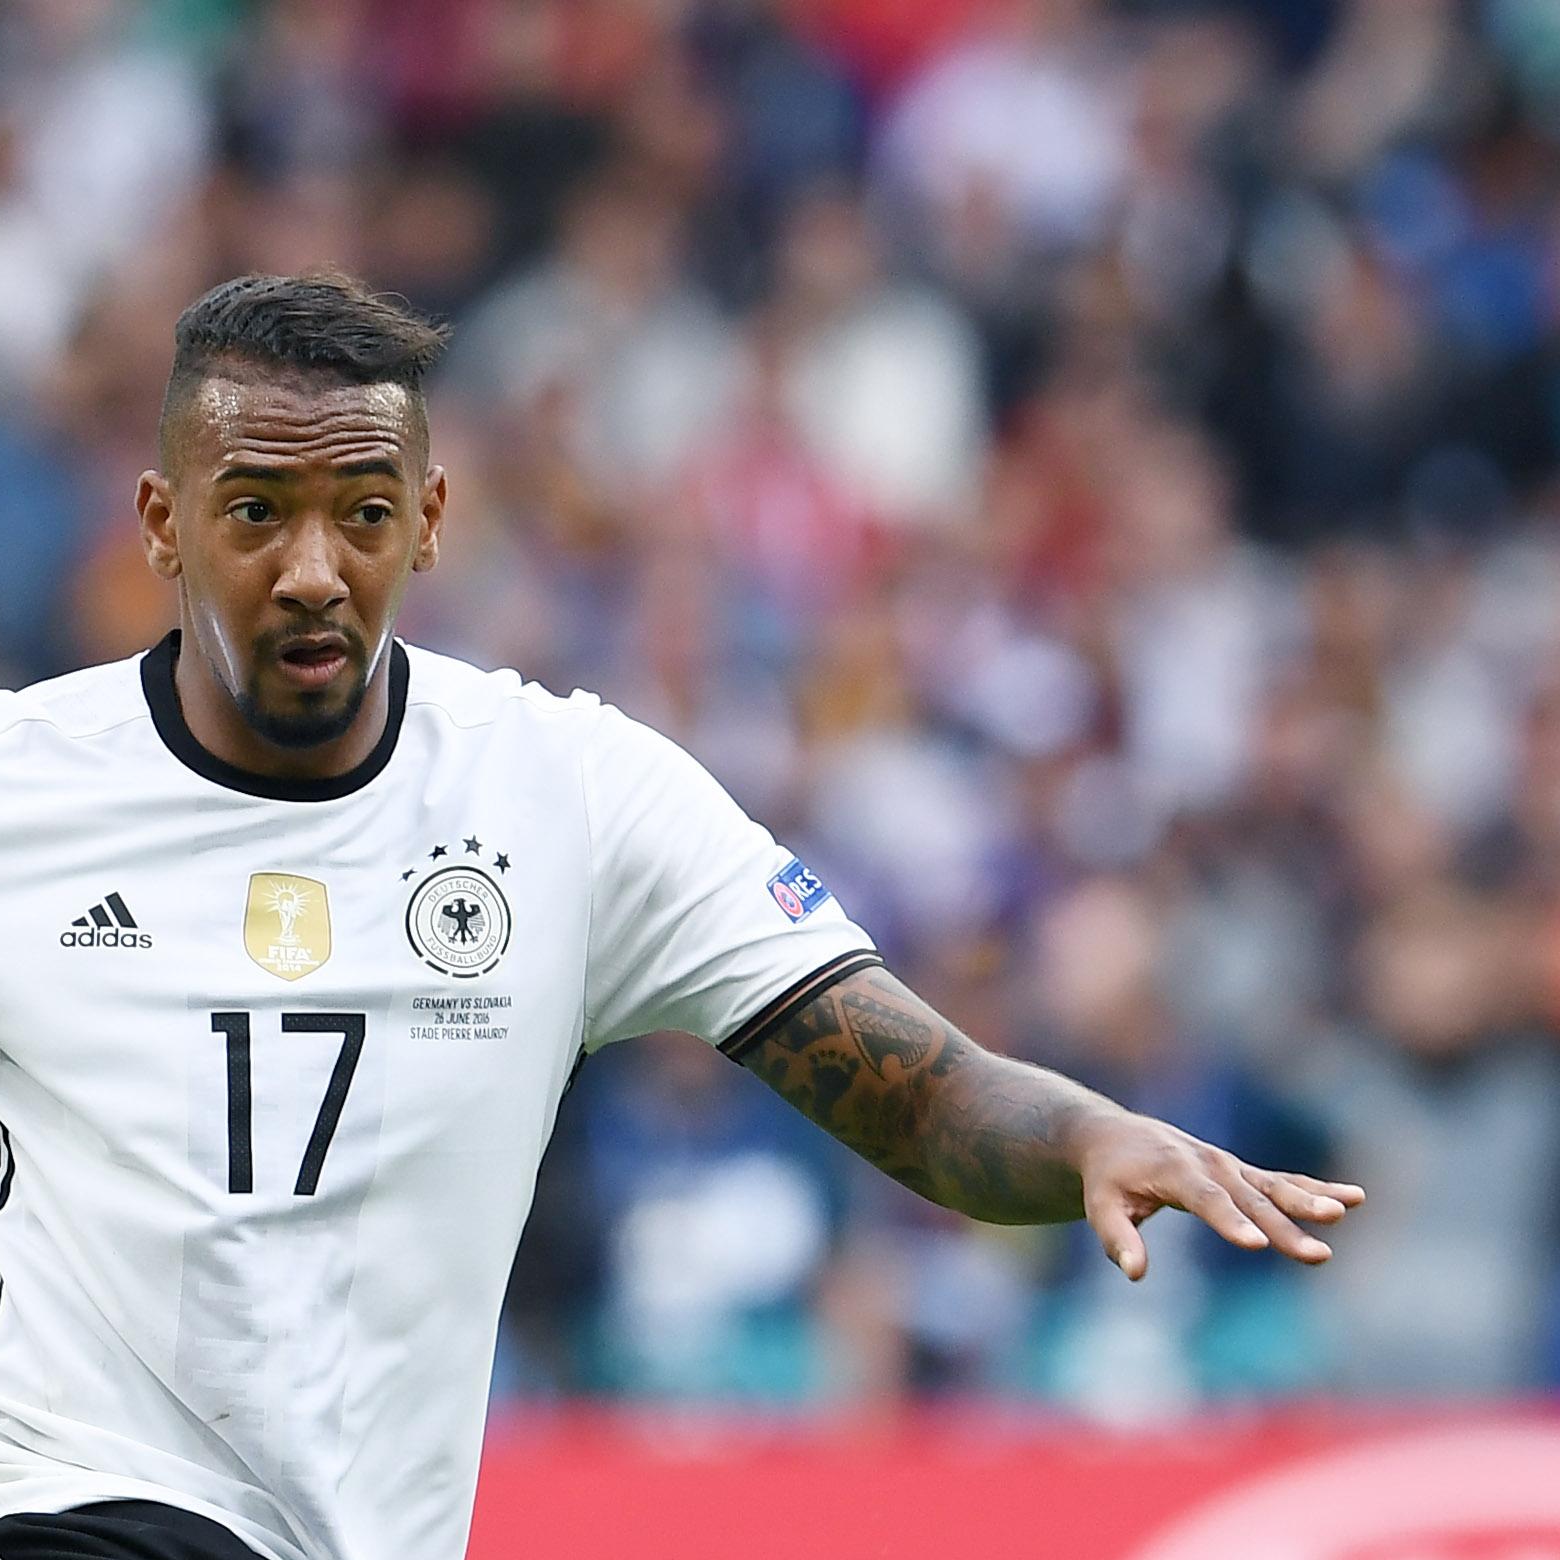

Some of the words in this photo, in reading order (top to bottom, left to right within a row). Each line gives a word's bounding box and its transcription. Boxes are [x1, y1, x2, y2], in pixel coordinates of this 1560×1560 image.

[428, 880, 489, 902] DEUTSCHER
[60, 926, 153, 949] adidas
[268, 945, 310, 960] FIFA
[412, 997, 458, 1010] GERMANY
[460, 998, 473, 1010] VS
[473, 996, 512, 1010] SLOVAKIA
[446, 1012, 470, 1025] JUNE
[472, 1012, 490, 1025] 2016
[410, 1027, 439, 1040] STADE
[441, 1027, 471, 1041] PIERRE
[474, 1026, 509, 1040] MAUROY
[210, 1011, 367, 1197] 17
